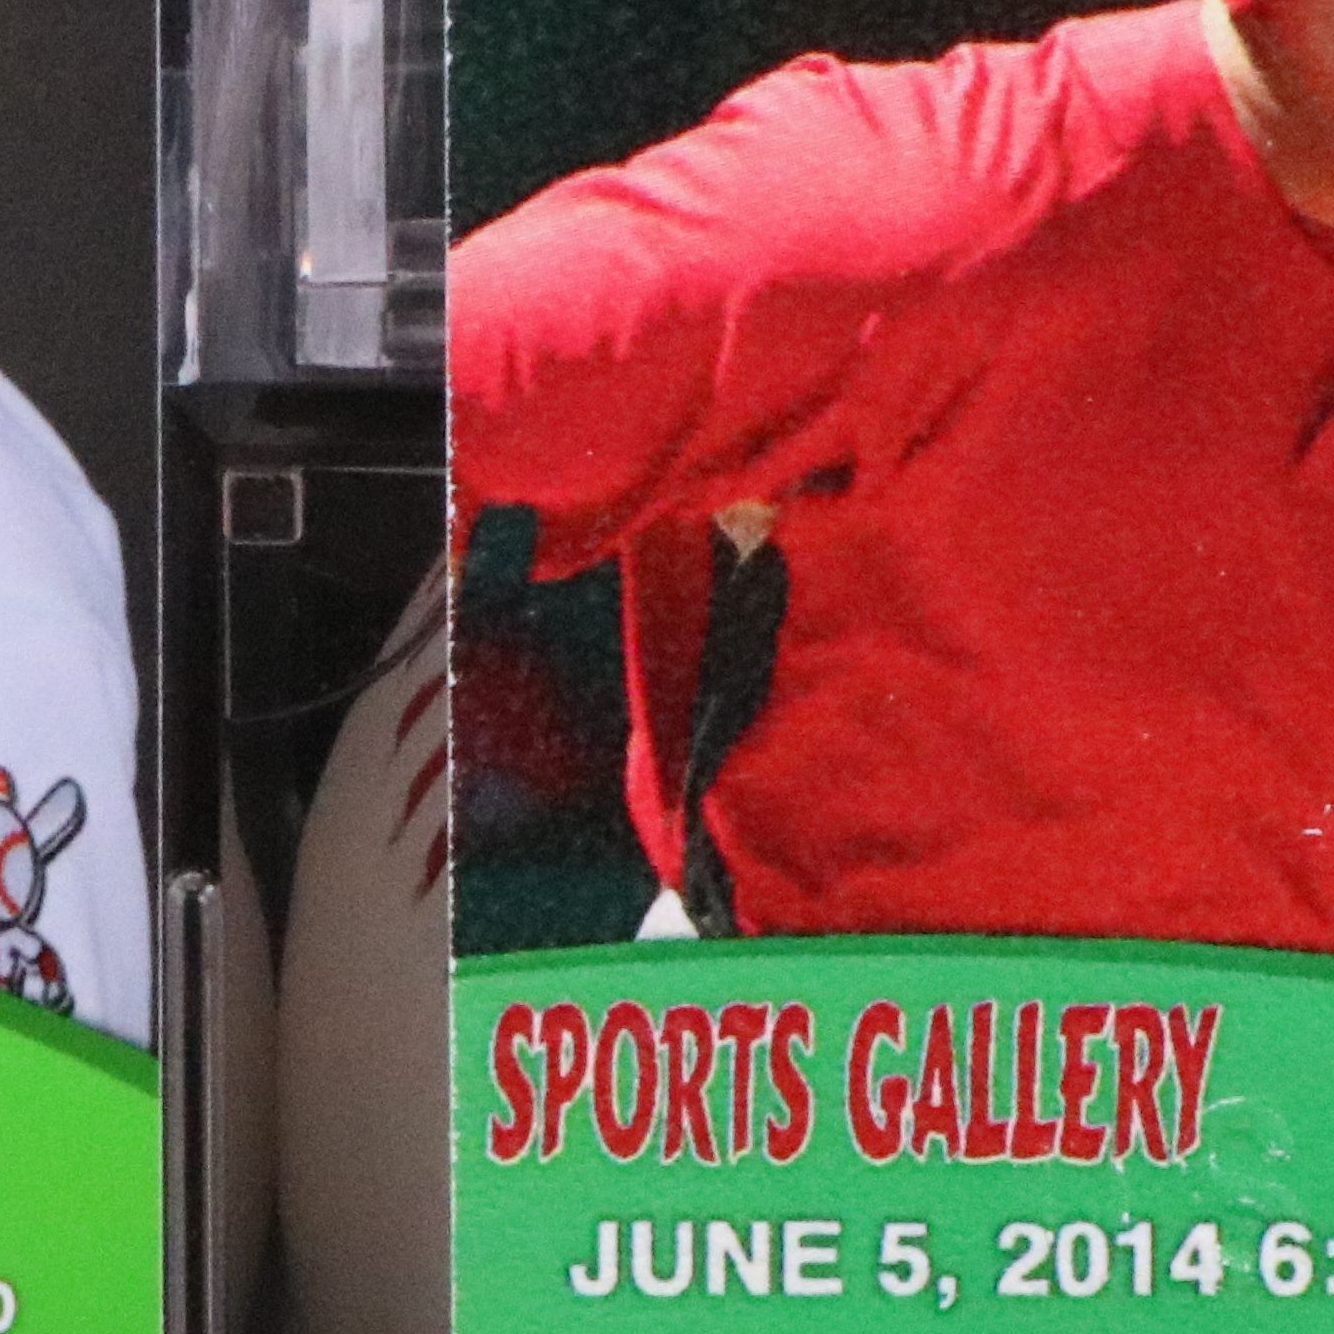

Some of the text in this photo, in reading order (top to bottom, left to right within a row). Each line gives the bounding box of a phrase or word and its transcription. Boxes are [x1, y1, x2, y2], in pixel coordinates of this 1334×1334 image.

[486, 998, 1226, 1167] SPORTS GALLERY
[569, 1219, 845, 1298] JUNE
[878, 1221, 960, 1309] 5,
[997, 1220, 1223, 1298] 2014
